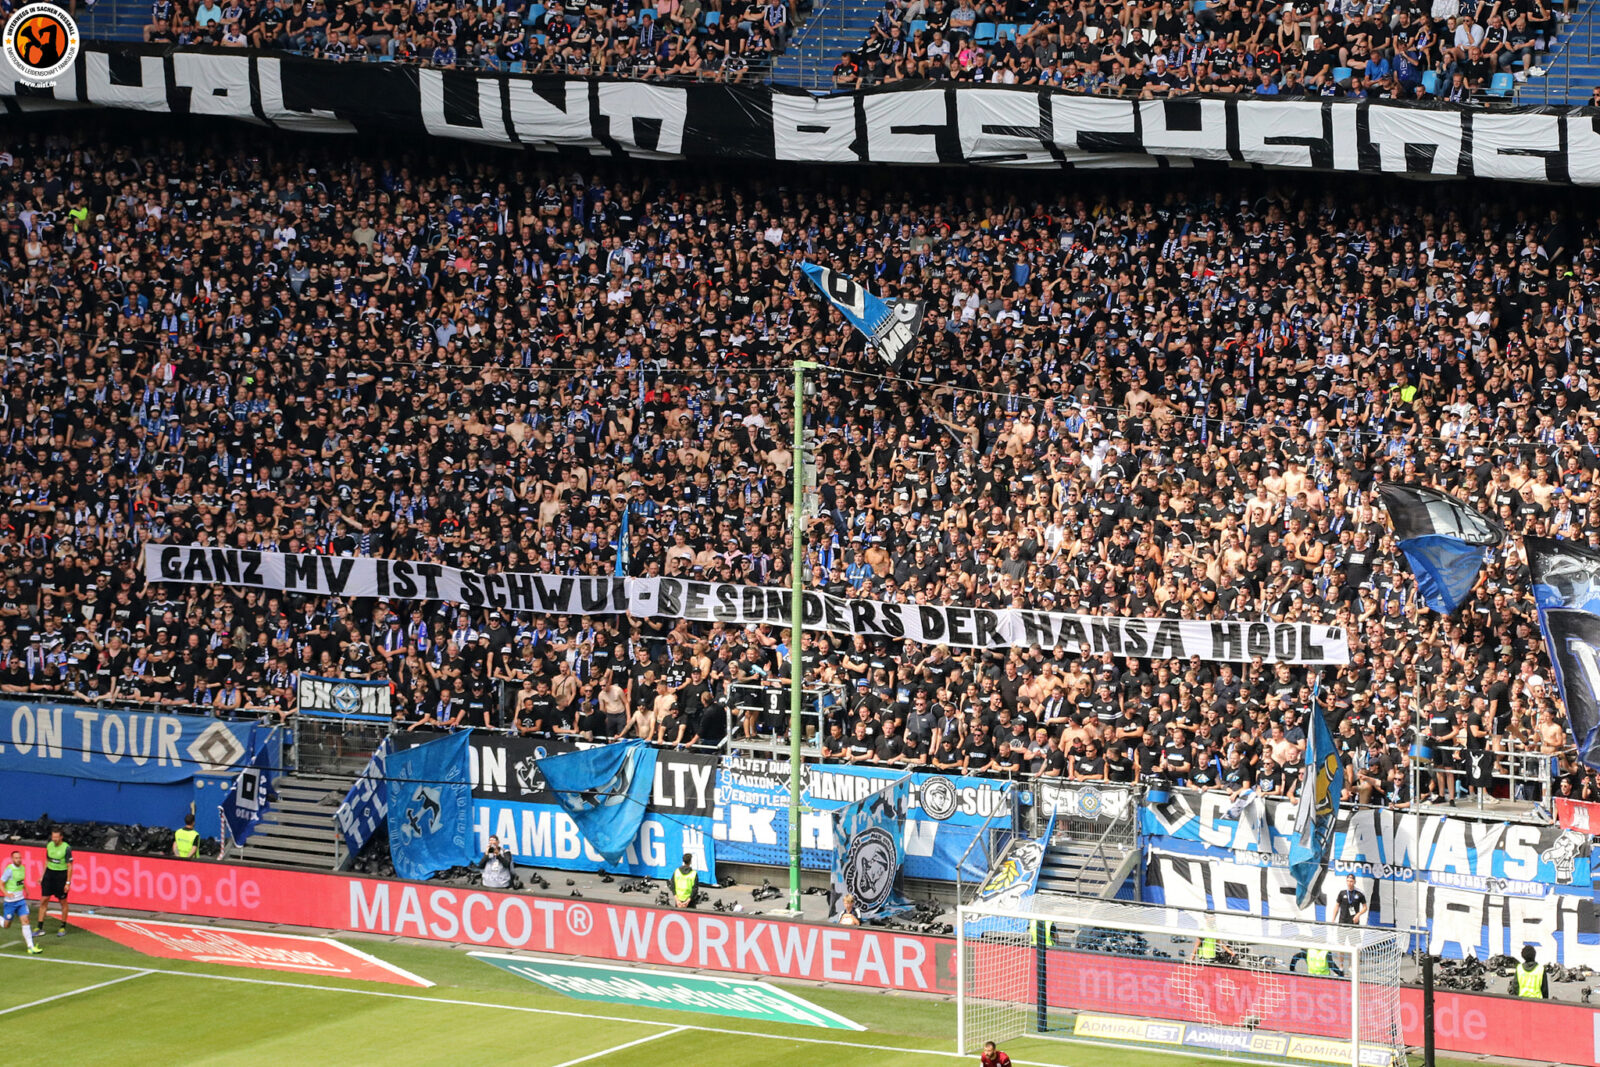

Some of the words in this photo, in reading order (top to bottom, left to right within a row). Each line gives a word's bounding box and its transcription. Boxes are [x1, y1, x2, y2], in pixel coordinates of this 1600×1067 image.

[160, 546, 264, 585] GANZ
[284, 554, 355, 593] MV
[376, 560, 442, 599] IST
[920, 606, 1001, 646] DER
[1023, 612, 1185, 660] HANSA
[12, 705, 63, 759] ON
[74, 710, 182, 768] TOUR
[1199, 790, 1542, 882] CASAWAYS
[1334, 860, 1372, 875] turn
[1393, 866, 1413, 880] up
[607, 906, 929, 990] WORKWEAR
